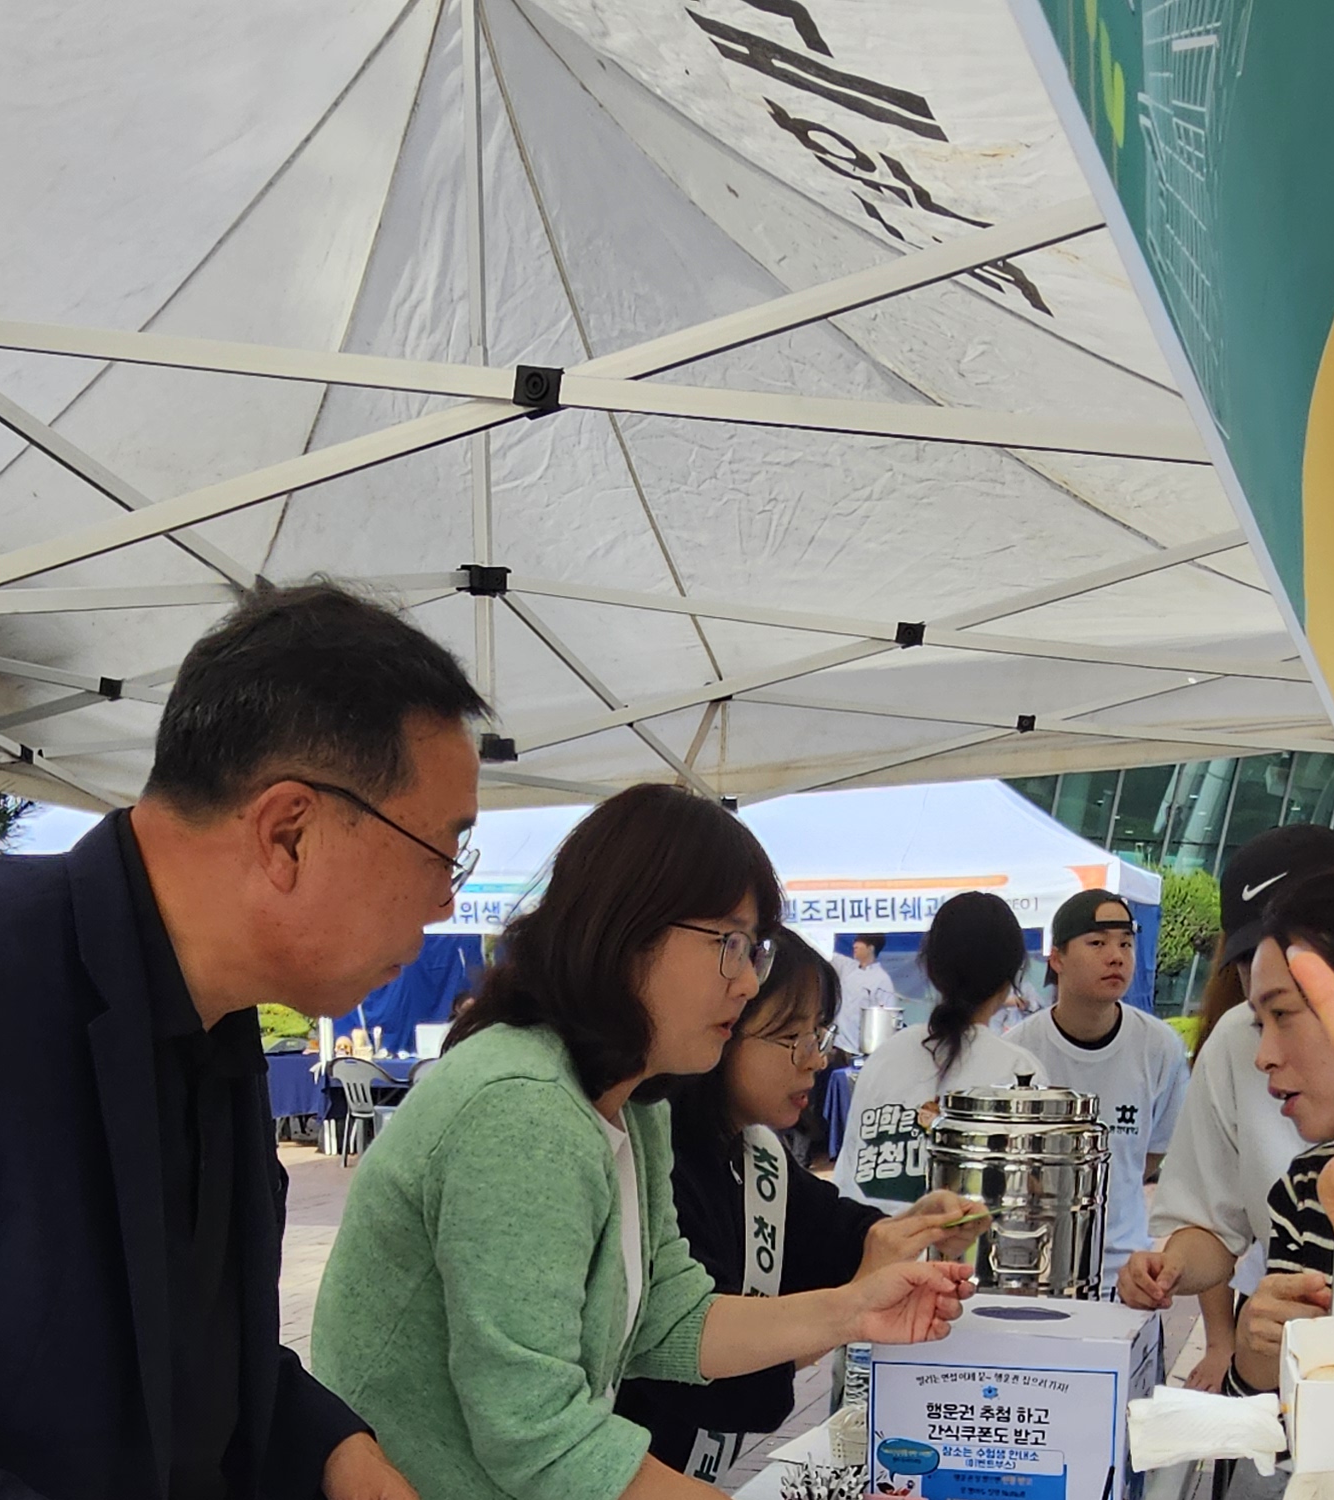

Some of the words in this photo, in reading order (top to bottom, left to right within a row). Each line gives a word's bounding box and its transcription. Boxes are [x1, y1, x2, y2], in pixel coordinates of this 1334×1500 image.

[926, 1402, 975, 1422] 행운권
[980, 1406, 1011, 1423] 추첨
[1017, 1408, 1050, 1425] 하고
[928, 1423, 1008, 1443] 간식쿠폰도
[1014, 1429, 1047, 1446] 받고
